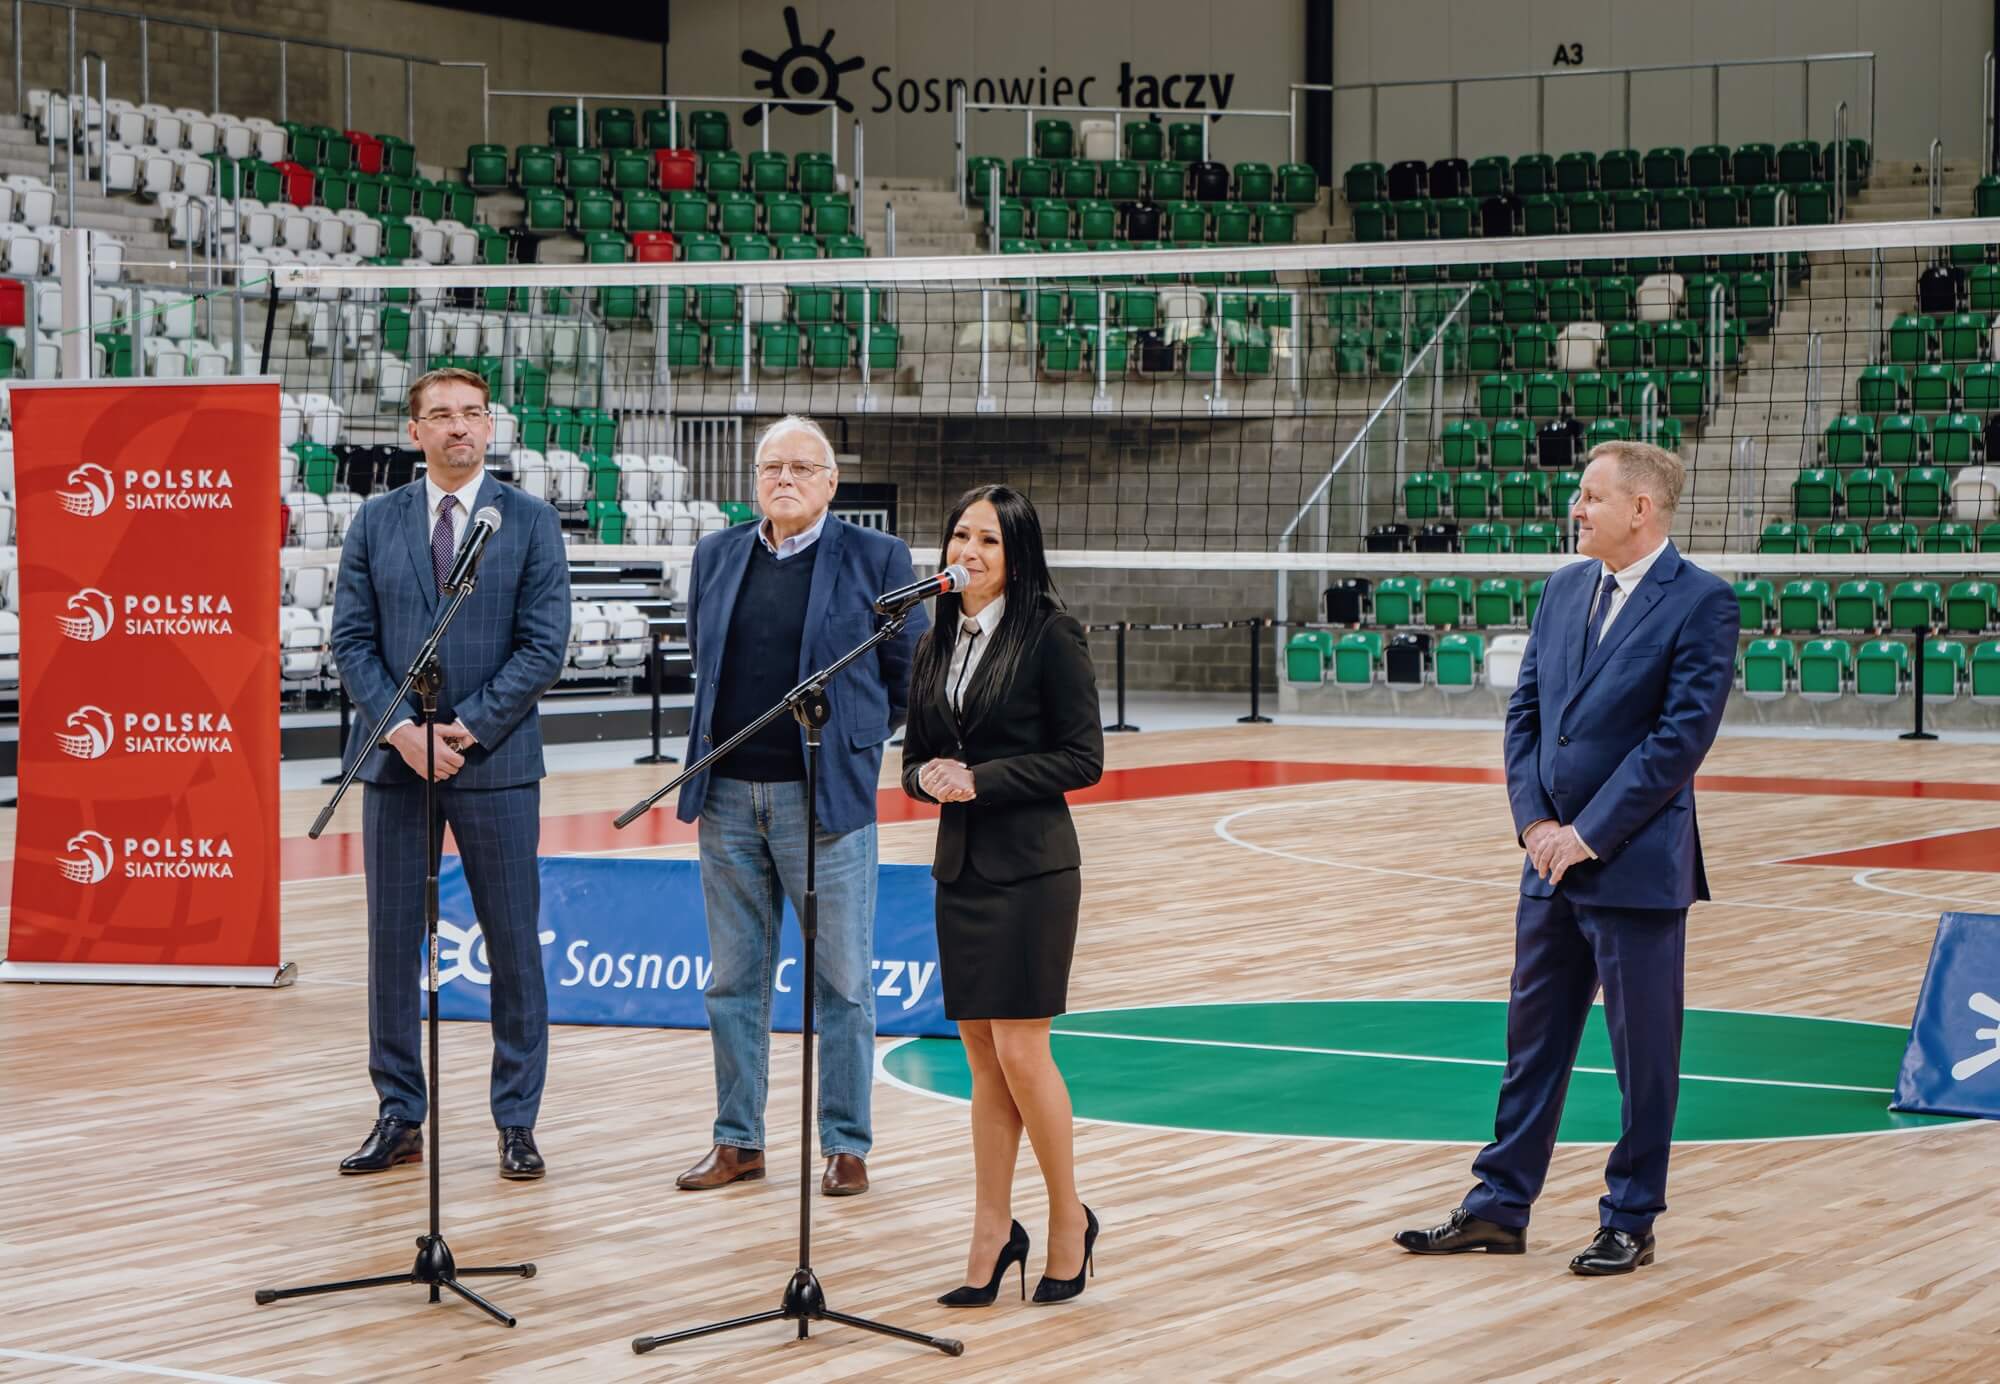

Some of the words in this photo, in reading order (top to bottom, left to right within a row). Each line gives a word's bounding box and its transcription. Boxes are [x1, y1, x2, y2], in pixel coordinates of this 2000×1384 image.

[1553, 43, 1583, 66] A3
[870, 66, 1096, 113] Sosnowiec
[1117, 62, 1234, 123] łączy
[125, 470, 232, 489] POLSKA
[125, 490, 233, 510] SIATKÓWKA
[125, 595, 232, 614] POLSKA
[125, 615, 233, 635] SIATKÓWKA
[125, 713, 232, 732] POLSKA
[125, 733, 233, 753] SIATKÓWKA
[125, 838, 232, 858] POLSKA
[125, 859, 233, 878] SIATKÓWKA
